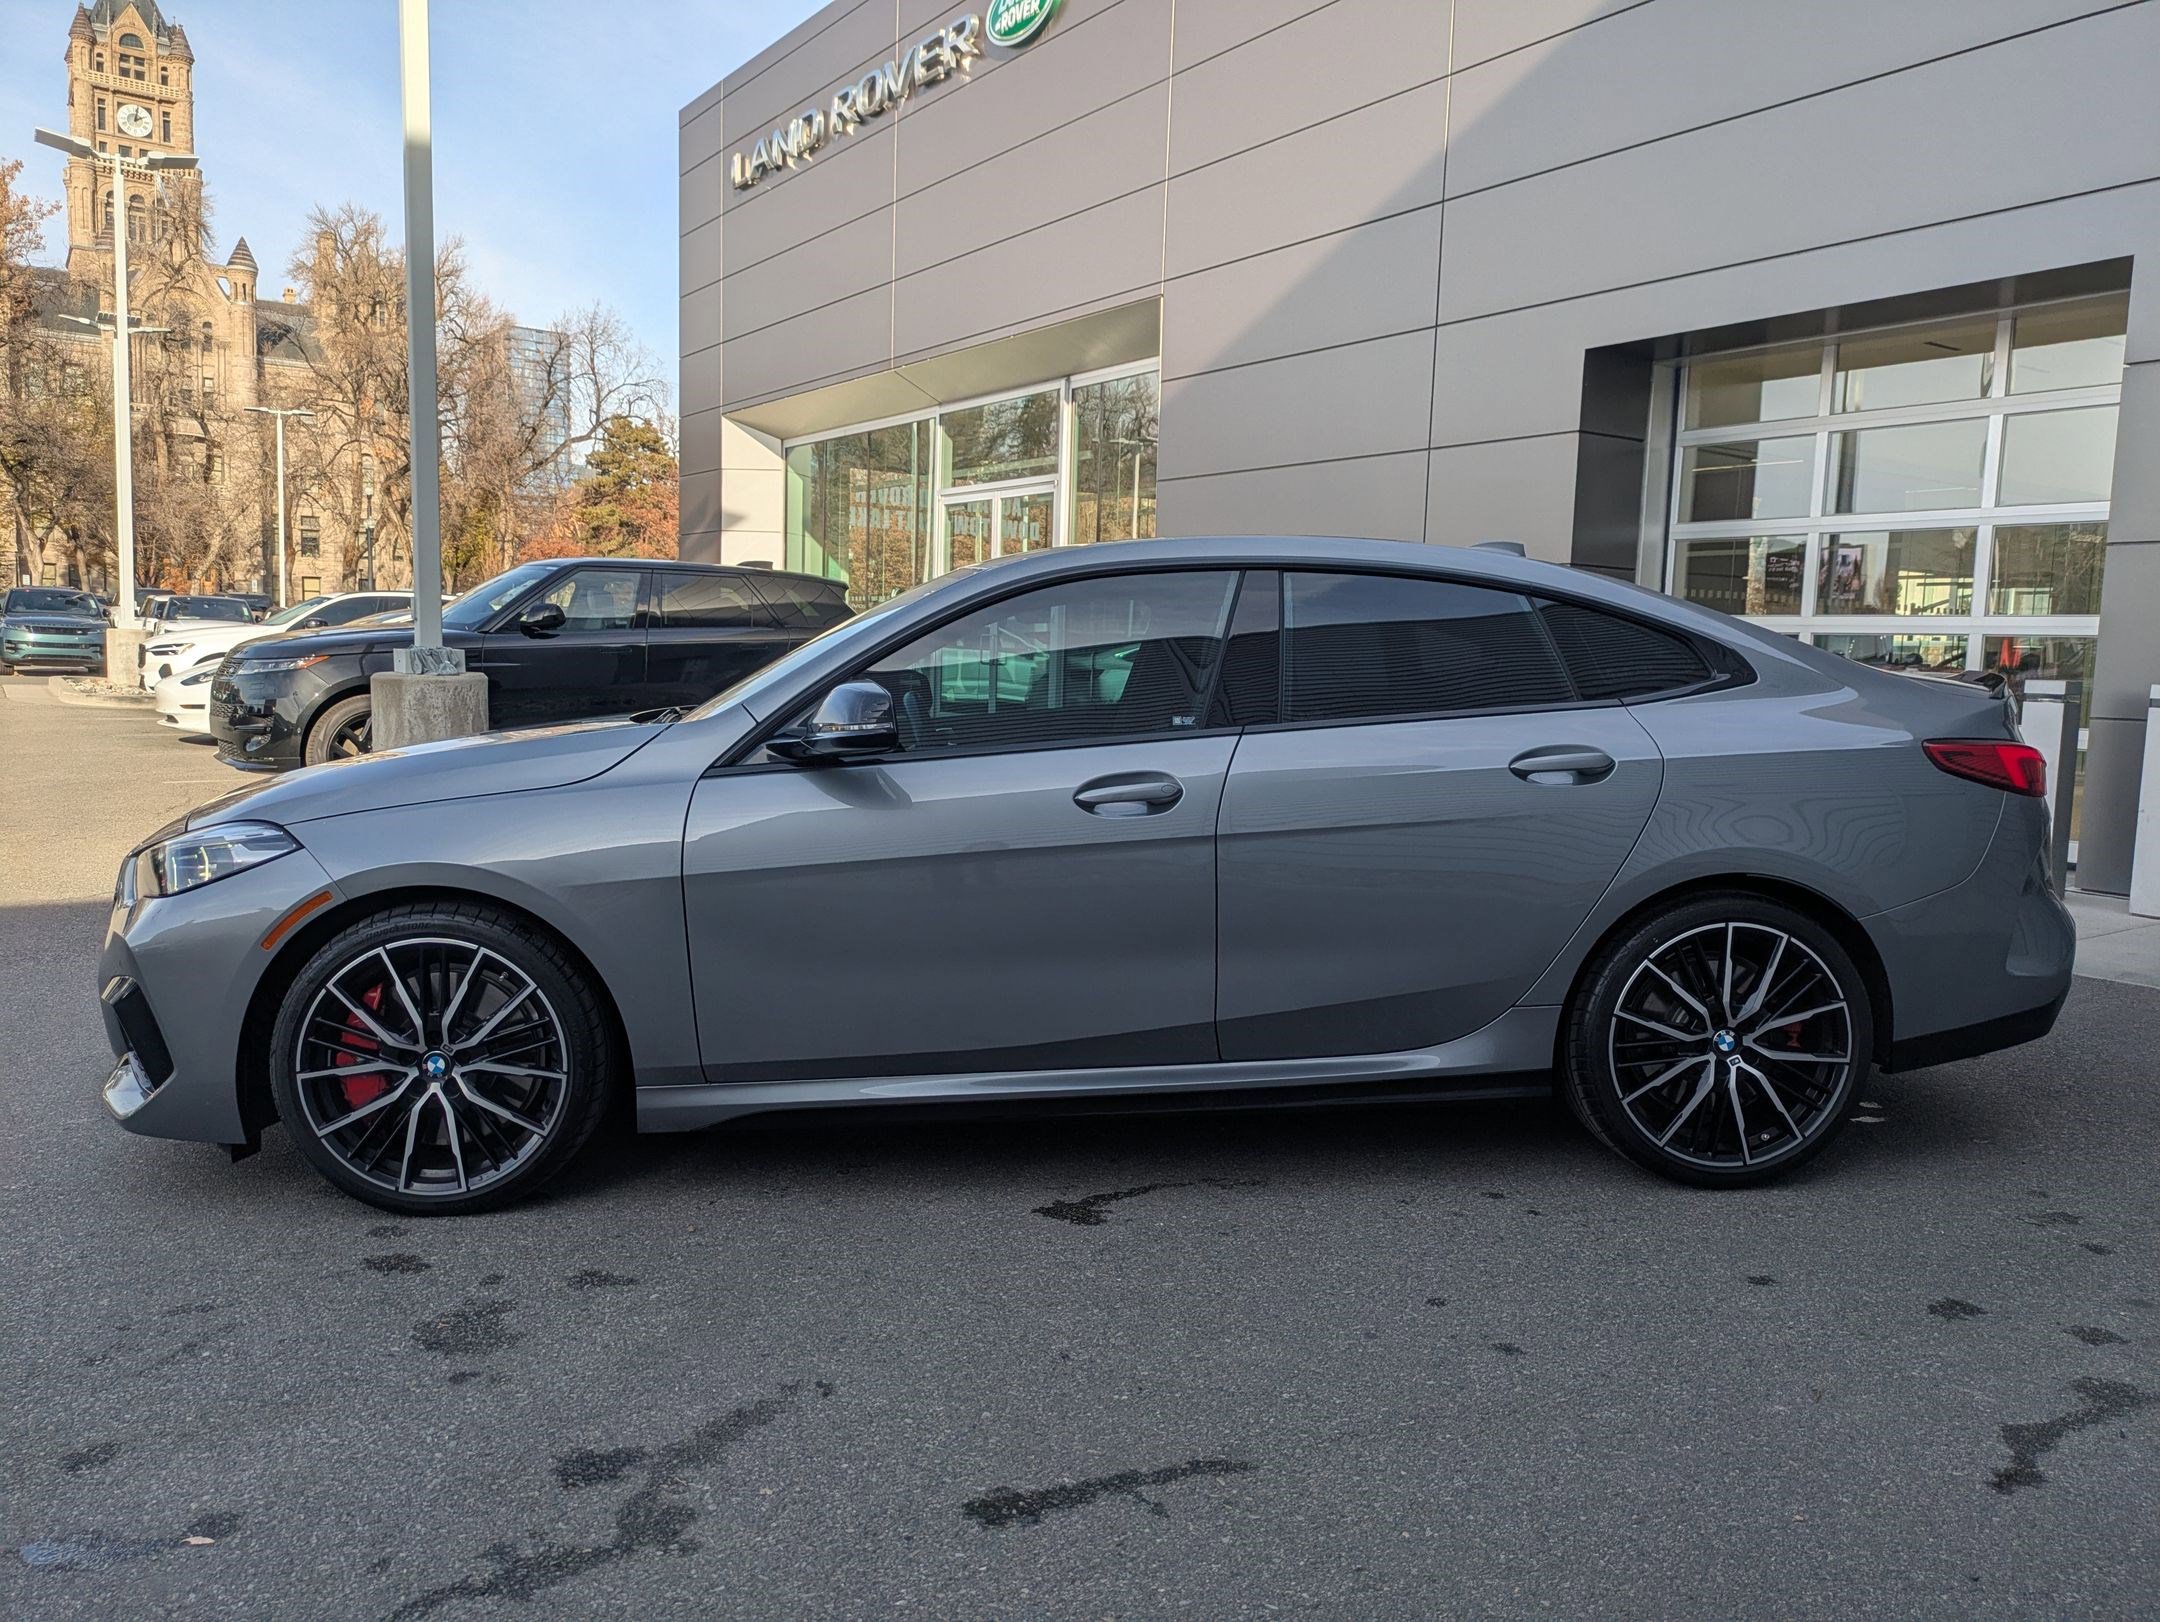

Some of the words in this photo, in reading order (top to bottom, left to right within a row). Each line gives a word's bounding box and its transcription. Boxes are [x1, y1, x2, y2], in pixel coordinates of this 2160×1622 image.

[1001, 0, 1040, 34] ROVER
[732, 108, 824, 190] LAND
[830, 13, 980, 135] ROVER
